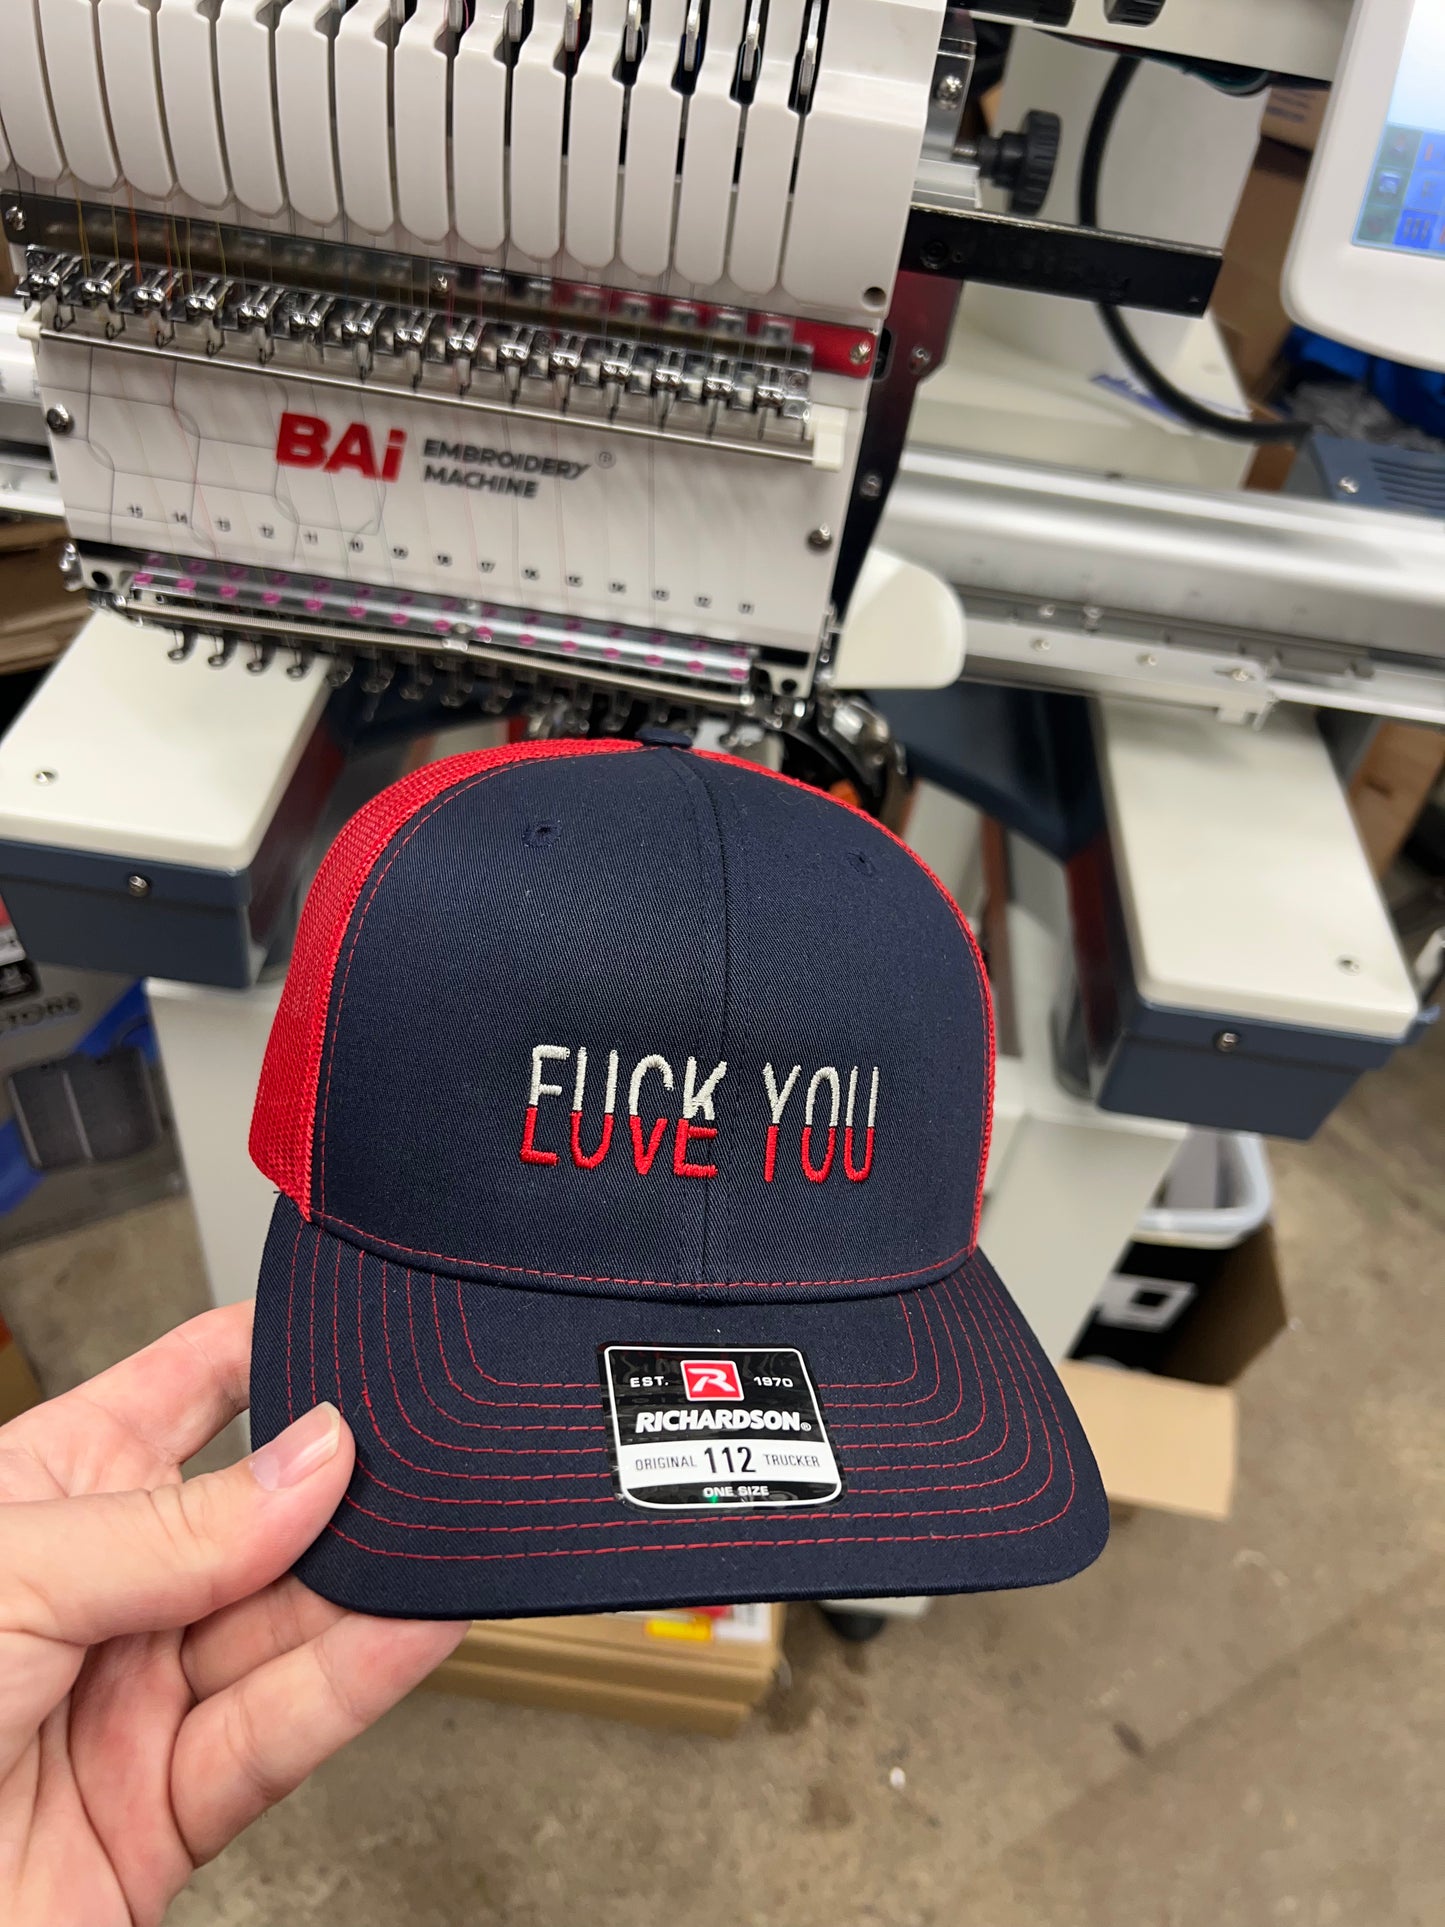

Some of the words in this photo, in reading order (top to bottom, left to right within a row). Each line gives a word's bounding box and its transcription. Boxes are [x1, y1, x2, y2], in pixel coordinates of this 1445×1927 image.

[276, 412, 407, 483] BAi
[423, 438, 590, 480] EMBROIDERY
[424, 465, 539, 499] MACHINE
[528, 1044, 728, 1120] FUCK
[762, 1061, 880, 1183] YOU
[629, 1375, 669, 1388] EST.
[753, 1375, 794, 1388] 1970
[635, 1455, 697, 1471] ORIGINAL
[704, 1446, 756, 1474] 112
[763, 1453, 820, 1468] TRUCKER
[702, 1486, 733, 1497] ONE
[738, 1485, 769, 1496] SIZE
